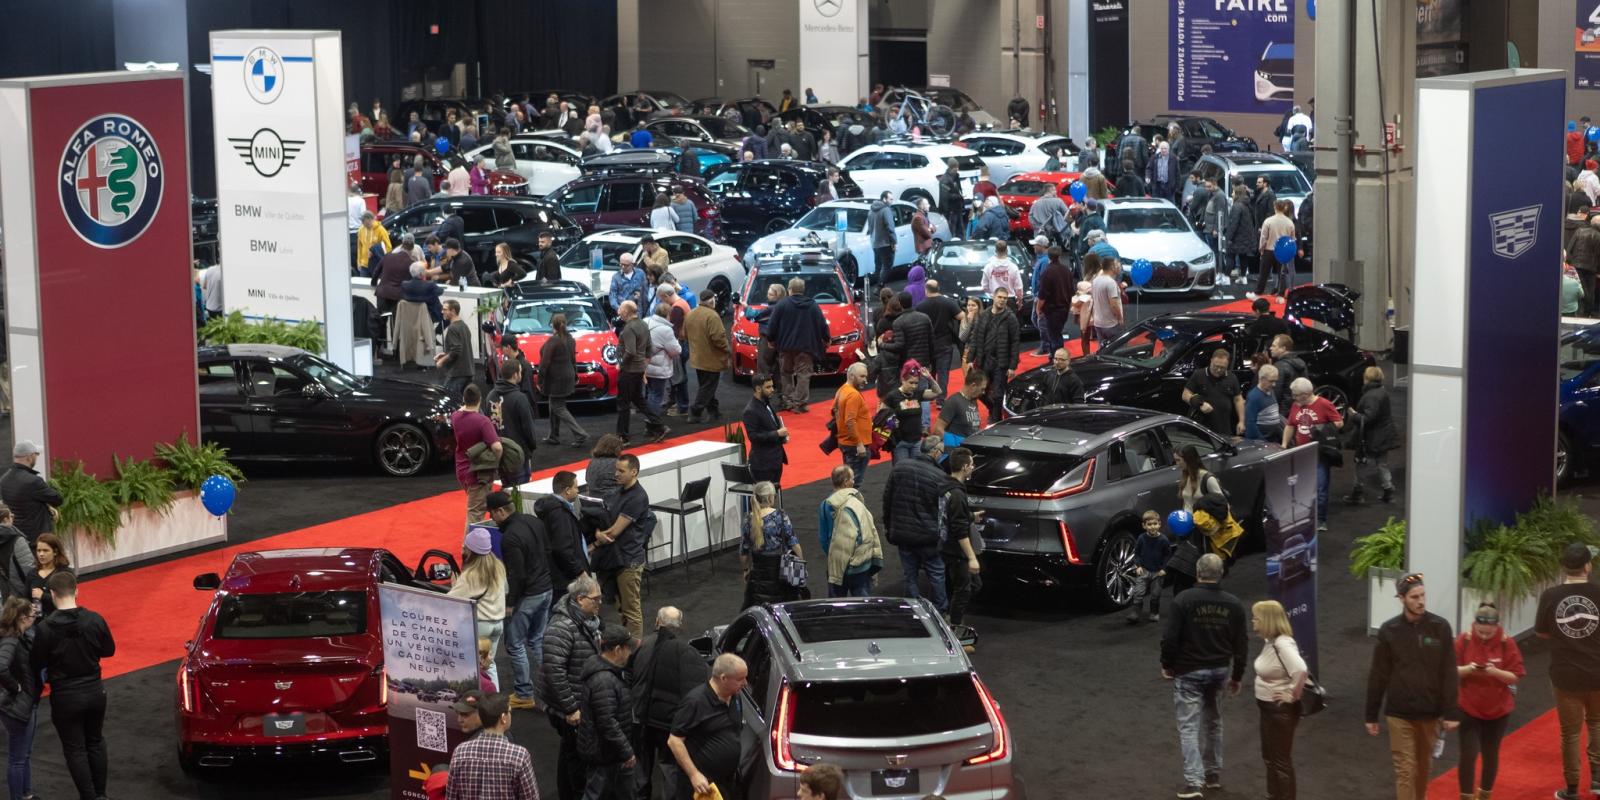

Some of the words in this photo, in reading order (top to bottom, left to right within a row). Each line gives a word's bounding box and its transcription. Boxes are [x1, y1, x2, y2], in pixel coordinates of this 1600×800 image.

[1177, 0, 1185, 14] VIS
[1215, 0, 1288, 11] FAIRE
[1264, 14, 1288, 23] .com
[1177, 17, 1185, 45] VOTRE
[1177, 47, 1185, 102] POURSUIVEZ
[63, 129, 95, 186] ALFA
[103, 120, 159, 178] ROMEO
[254, 146, 281, 160] MINI
[234, 204, 262, 218] BMW
[250, 239, 278, 253] BMW
[247, 288, 266, 298] MINI
[1286, 603, 1308, 617] YRIQ
[401, 610, 448, 626] COUREZ
[391, 618, 407, 628] LA
[411, 623, 458, 639] CHANCE
[392, 629, 407, 638] DE
[412, 633, 459, 648] GAGNER
[387, 638, 402, 647] UN
[407, 641, 465, 660] VÉHICULE
[398, 650, 456, 668] CADILLAC
[409, 662, 440, 674] NEUF
[402, 790, 430, 800] CONCOU
